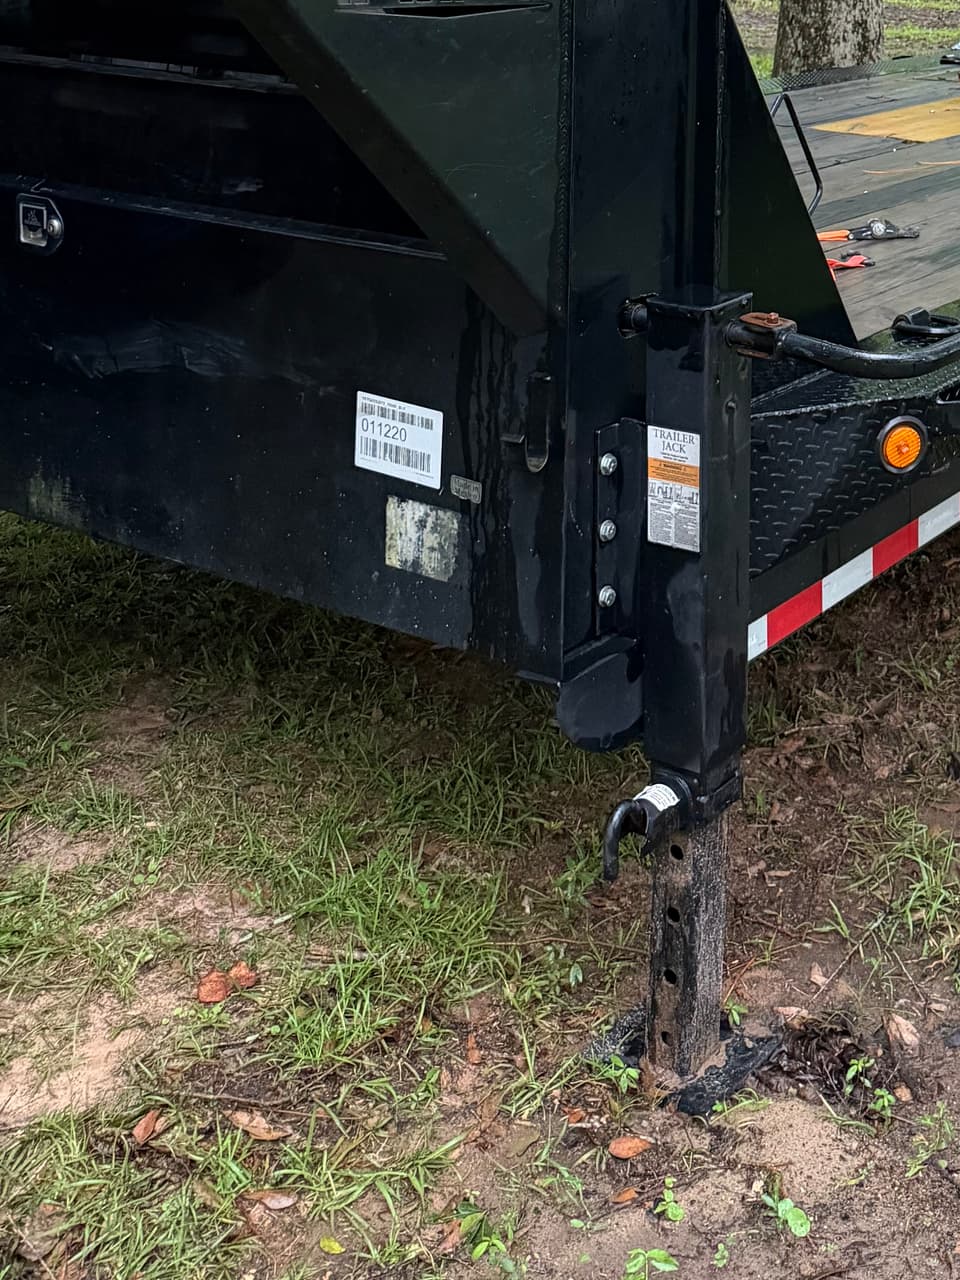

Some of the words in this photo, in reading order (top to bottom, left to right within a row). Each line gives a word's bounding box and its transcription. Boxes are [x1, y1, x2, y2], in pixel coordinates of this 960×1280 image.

[361, 418, 407, 442] 011220
[654, 428, 695, 445] TRAILER
[662, 440, 687, 454] JACK
